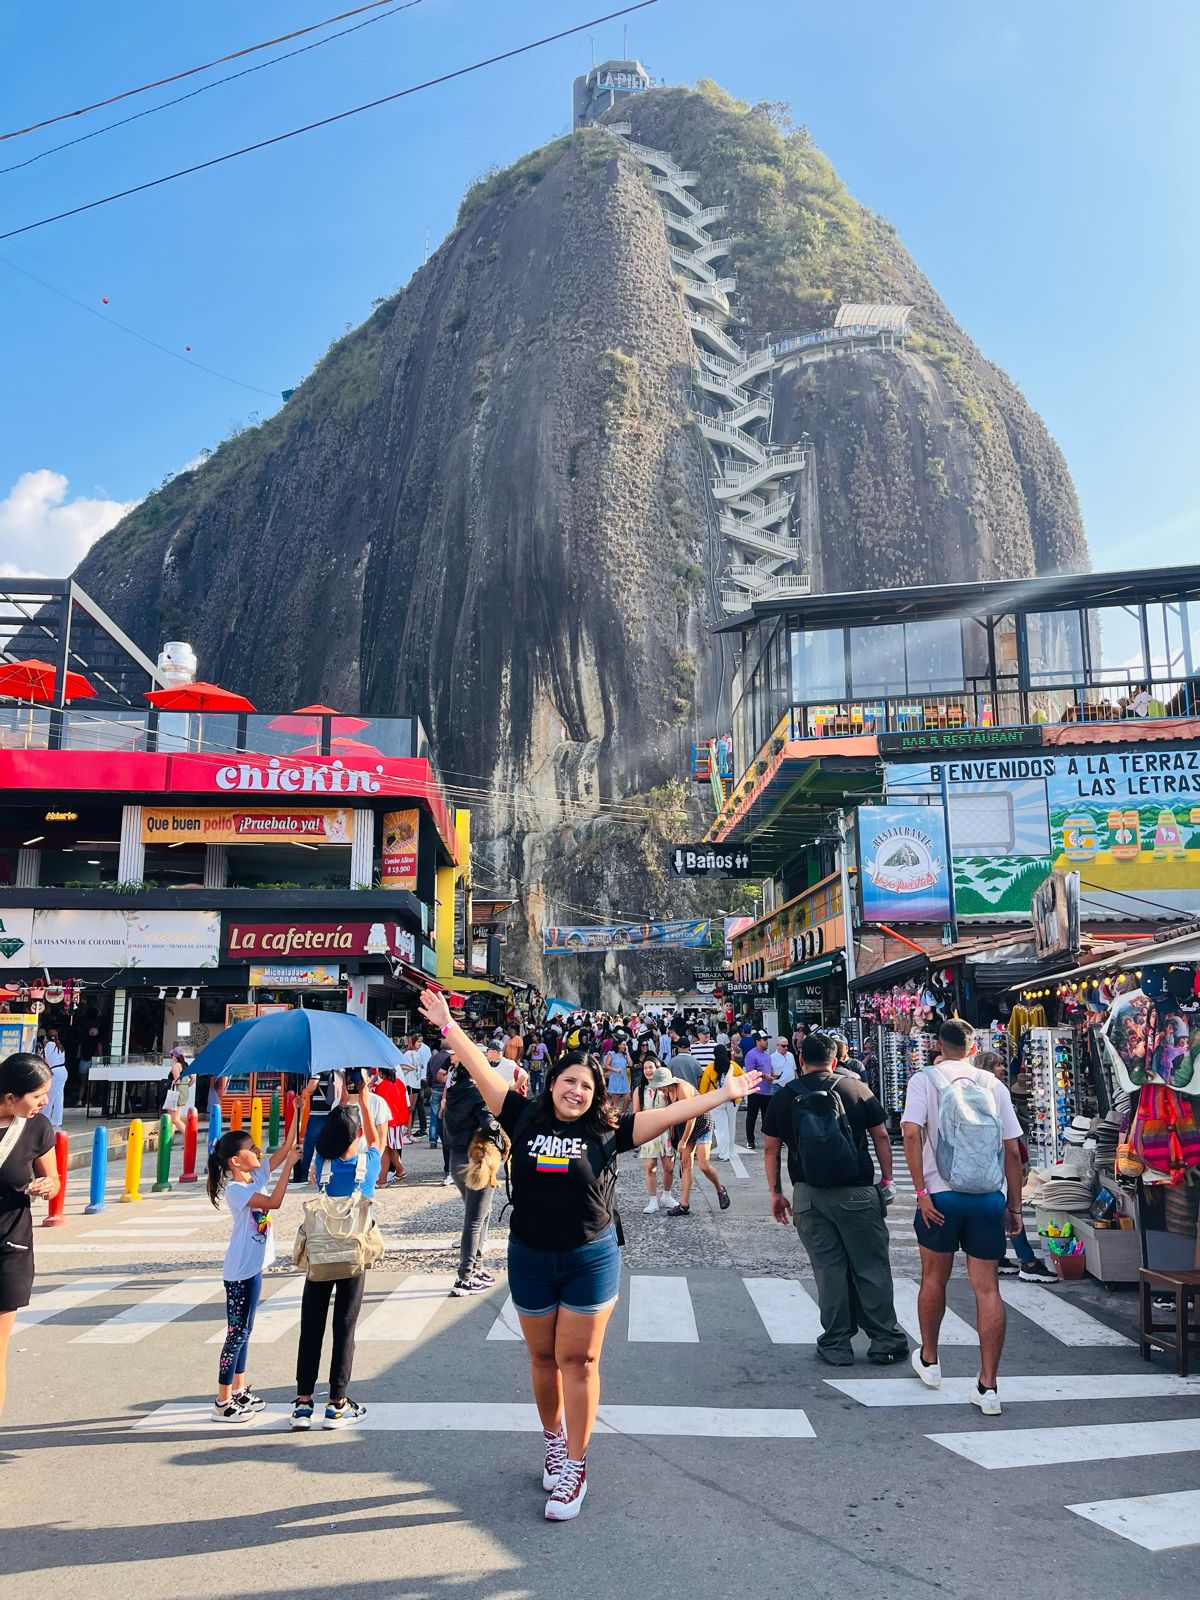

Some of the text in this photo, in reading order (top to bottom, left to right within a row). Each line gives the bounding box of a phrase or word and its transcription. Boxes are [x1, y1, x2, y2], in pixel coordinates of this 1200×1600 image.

[902, 736, 926, 746] BAR
[943, 731, 1025, 745] RESTAURANT
[215, 758, 384, 793] chickin'
[930, 752, 1199, 782] BENVENIDOS A LA TERRAZ
[1078, 773, 1200, 797] LAS LETRAS
[146, 815, 232, 833] Que buen pollo
[239, 816, 320, 833] ¡Pruebalo ya!
[872, 826, 933, 847] RESTAURANTE
[686, 851, 733, 869] Baños
[33, 937, 126, 946] ARTESANÍAS DE COLOMBIA
[230, 925, 353, 955] La cafetería
[264, 968, 304, 976] Micheladas
[728, 982, 753, 991] Baños
[806, 986, 821, 995] WC
[531, 1134, 582, 1157] PARCE
